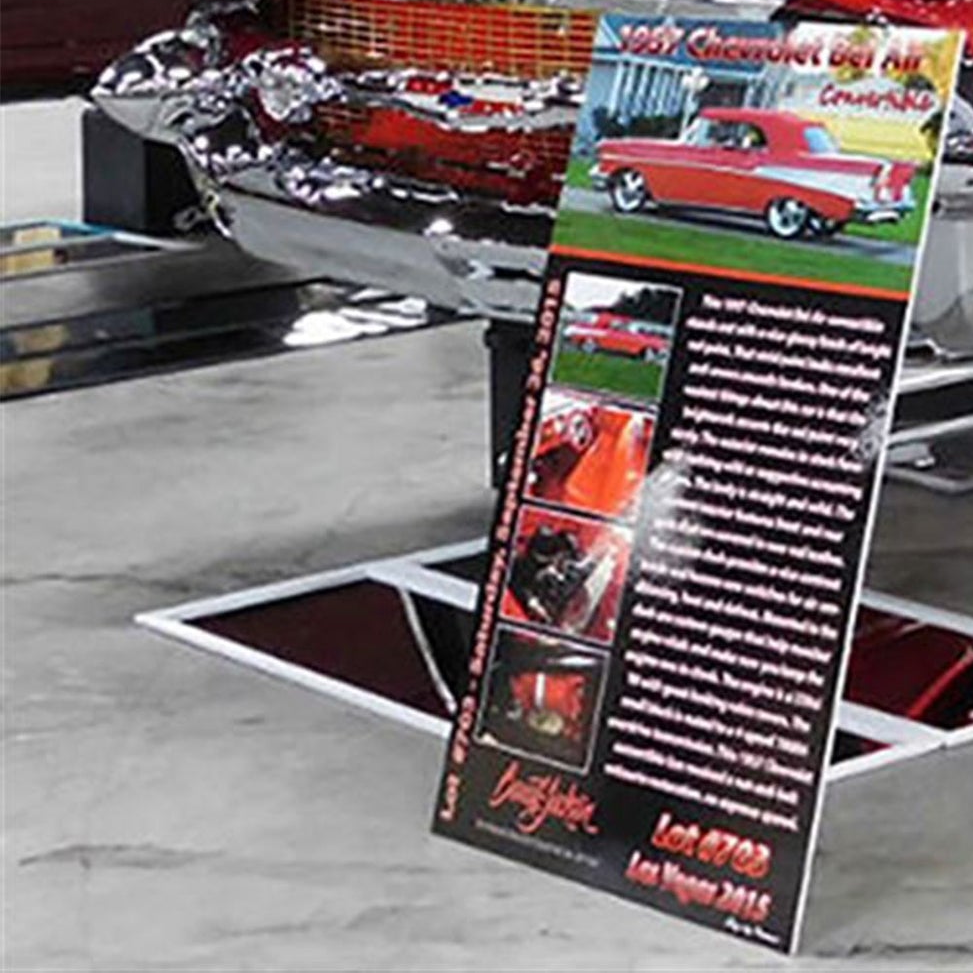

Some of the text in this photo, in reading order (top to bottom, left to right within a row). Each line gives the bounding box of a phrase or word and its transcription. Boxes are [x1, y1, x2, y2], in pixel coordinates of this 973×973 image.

[619, 24, 924, 72] 1957 Chevrolet Bel Air
[818, 83, 934, 113] Convertible
[439, 772, 461, 820] Lot
[452, 695, 477, 763] #703
[468, 548, 507, 675] Saturday,
[495, 395, 537, 540] September
[651, 812, 701, 858] Lot
[696, 828, 772, 879] #703
[625, 850, 772, 922] Las Vegas 2015
